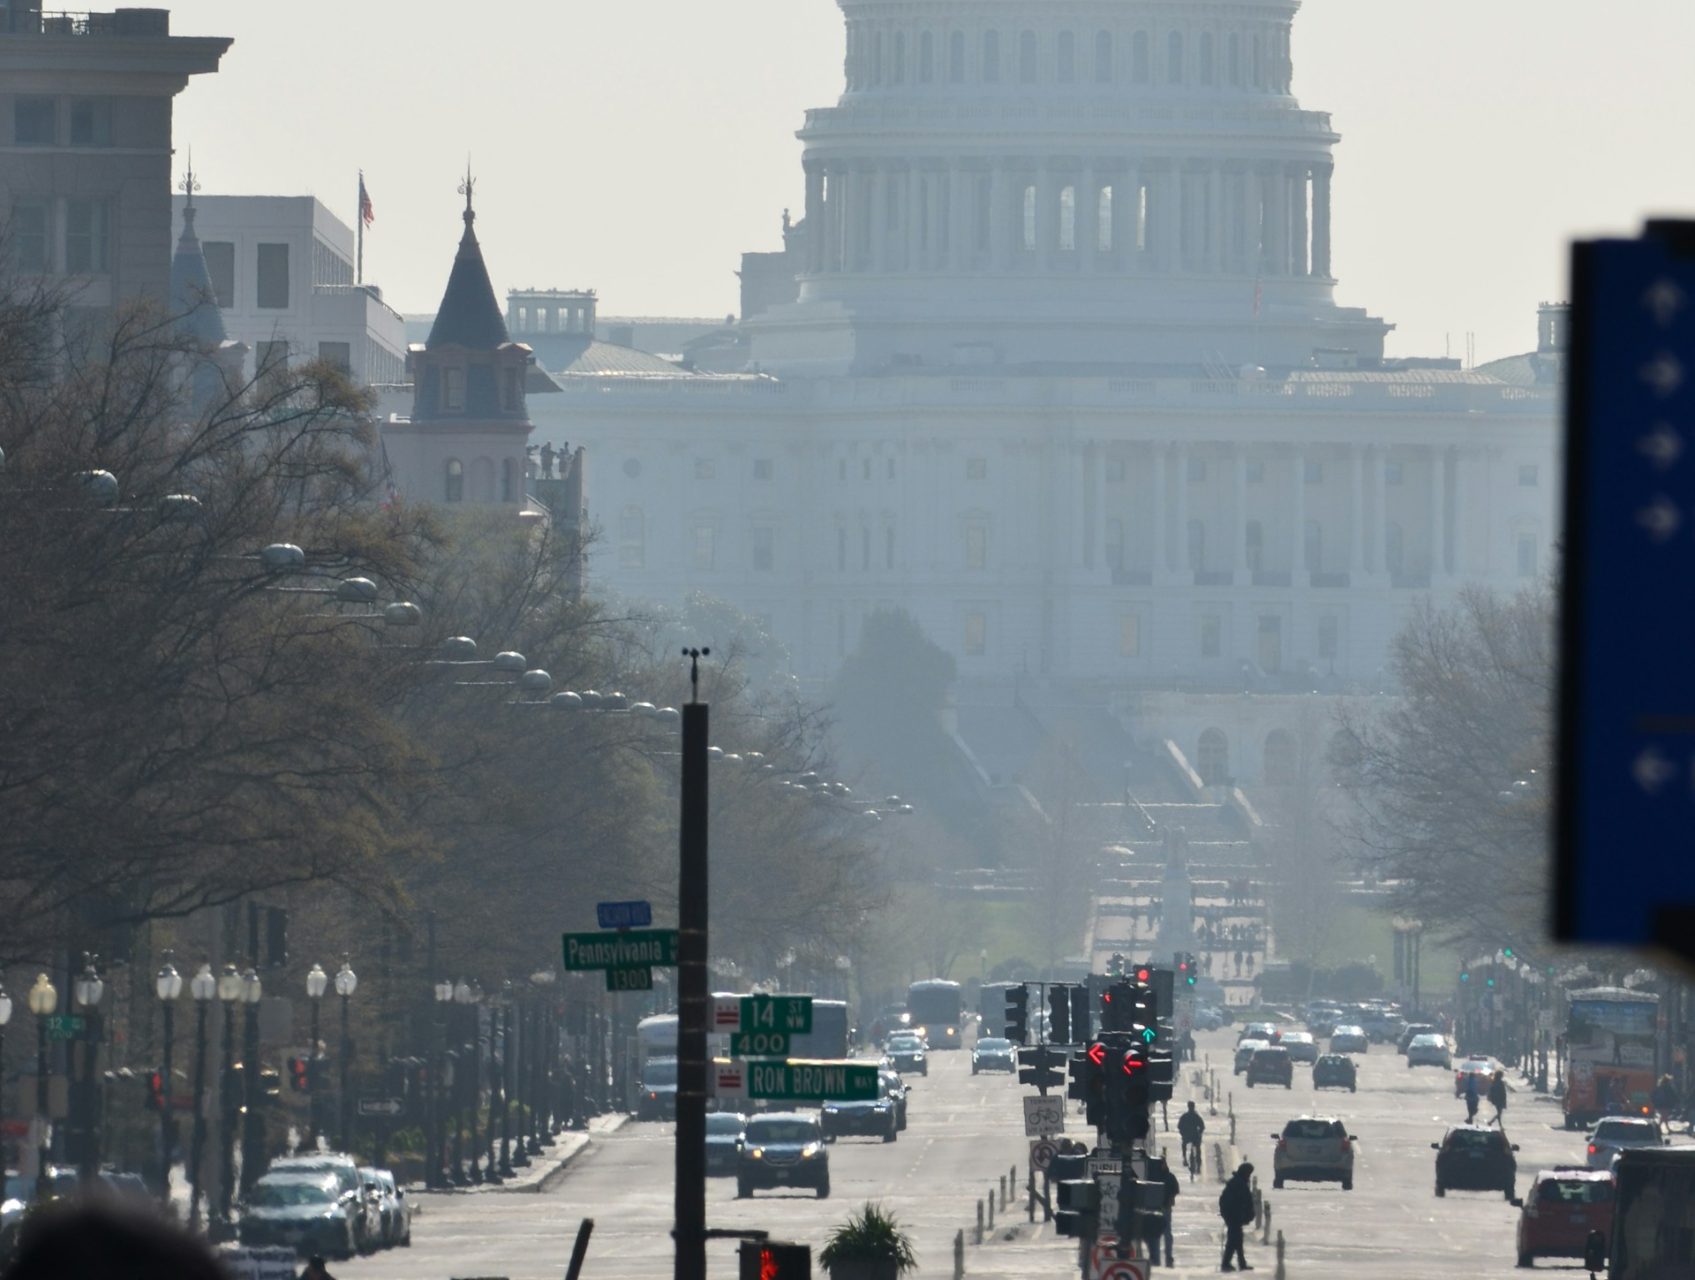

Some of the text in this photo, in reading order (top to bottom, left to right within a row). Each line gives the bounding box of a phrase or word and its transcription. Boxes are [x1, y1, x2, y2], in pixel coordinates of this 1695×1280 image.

[569, 937, 662, 965] Pennsylvania
[614, 969, 648, 988] 1300
[751, 1000, 803, 1028] 14 ST
[786, 1015, 804, 1028] NW
[738, 1034, 785, 1052] 400
[754, 1067, 873, 1094] RON BROWN WAY
